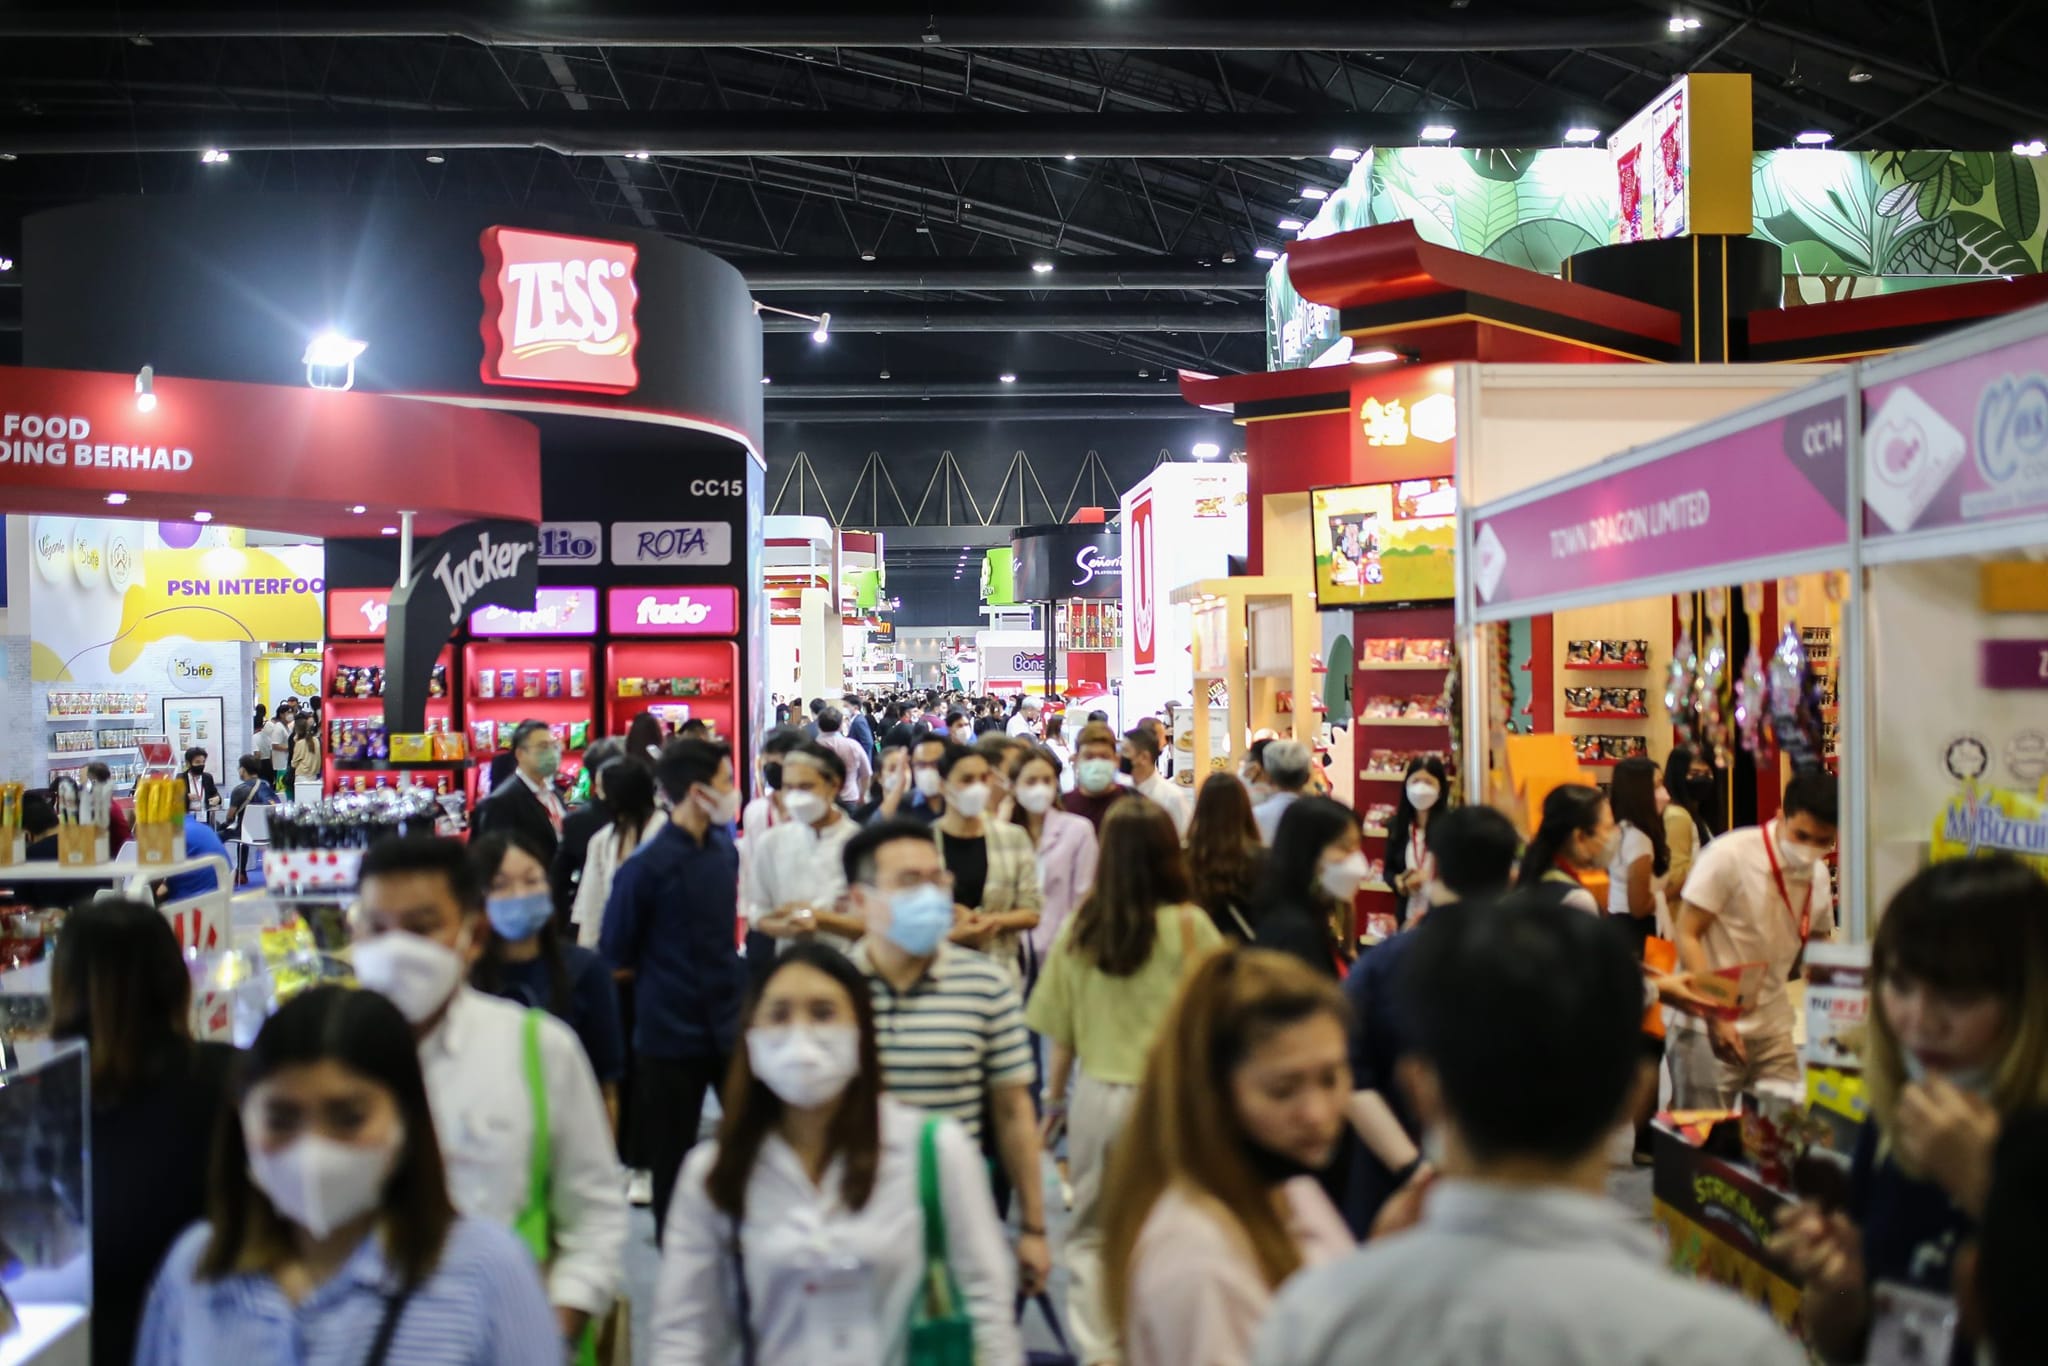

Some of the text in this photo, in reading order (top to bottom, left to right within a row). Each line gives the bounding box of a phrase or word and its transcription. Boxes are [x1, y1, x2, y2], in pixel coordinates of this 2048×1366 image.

[508, 259, 618, 346] ZESS
[4, 415, 90, 440] FOOD
[1802, 418, 1842, 456] CC14
[74, 444, 193, 471] BERHAD
[690, 480, 743, 496] CC15
[1550, 490, 1710, 558] TOWN DRAGON LIMITED
[538, 529, 596, 559] lio
[637, 528, 706, 558] ROTA
[167, 580, 211, 596] PSN
[432, 532, 525, 625] Jacker
